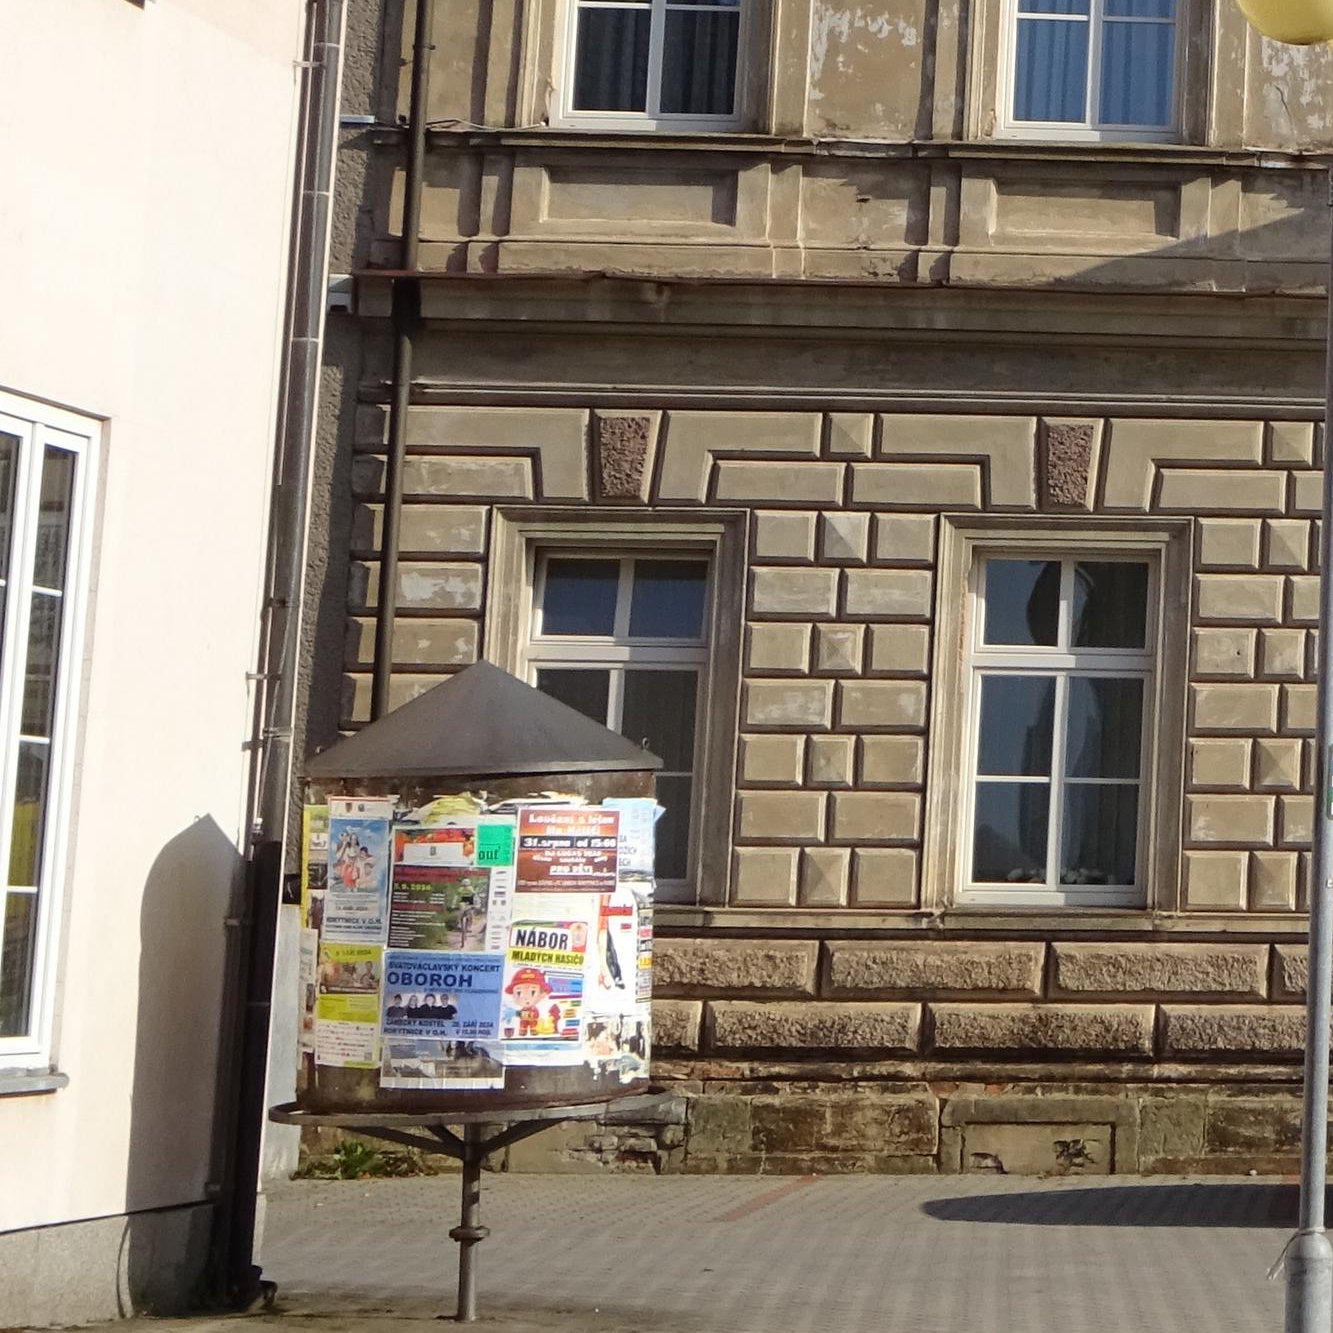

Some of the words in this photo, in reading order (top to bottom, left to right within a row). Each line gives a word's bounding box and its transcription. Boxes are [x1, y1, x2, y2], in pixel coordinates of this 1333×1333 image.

[516, 927, 568, 950] NÁBOR
[511, 950, 553, 963] MLADÝCH
[555, 952, 584, 965] HASIČŮ
[460, 963, 501, 973] KONCERT
[387, 971, 473, 988] OBOROH
